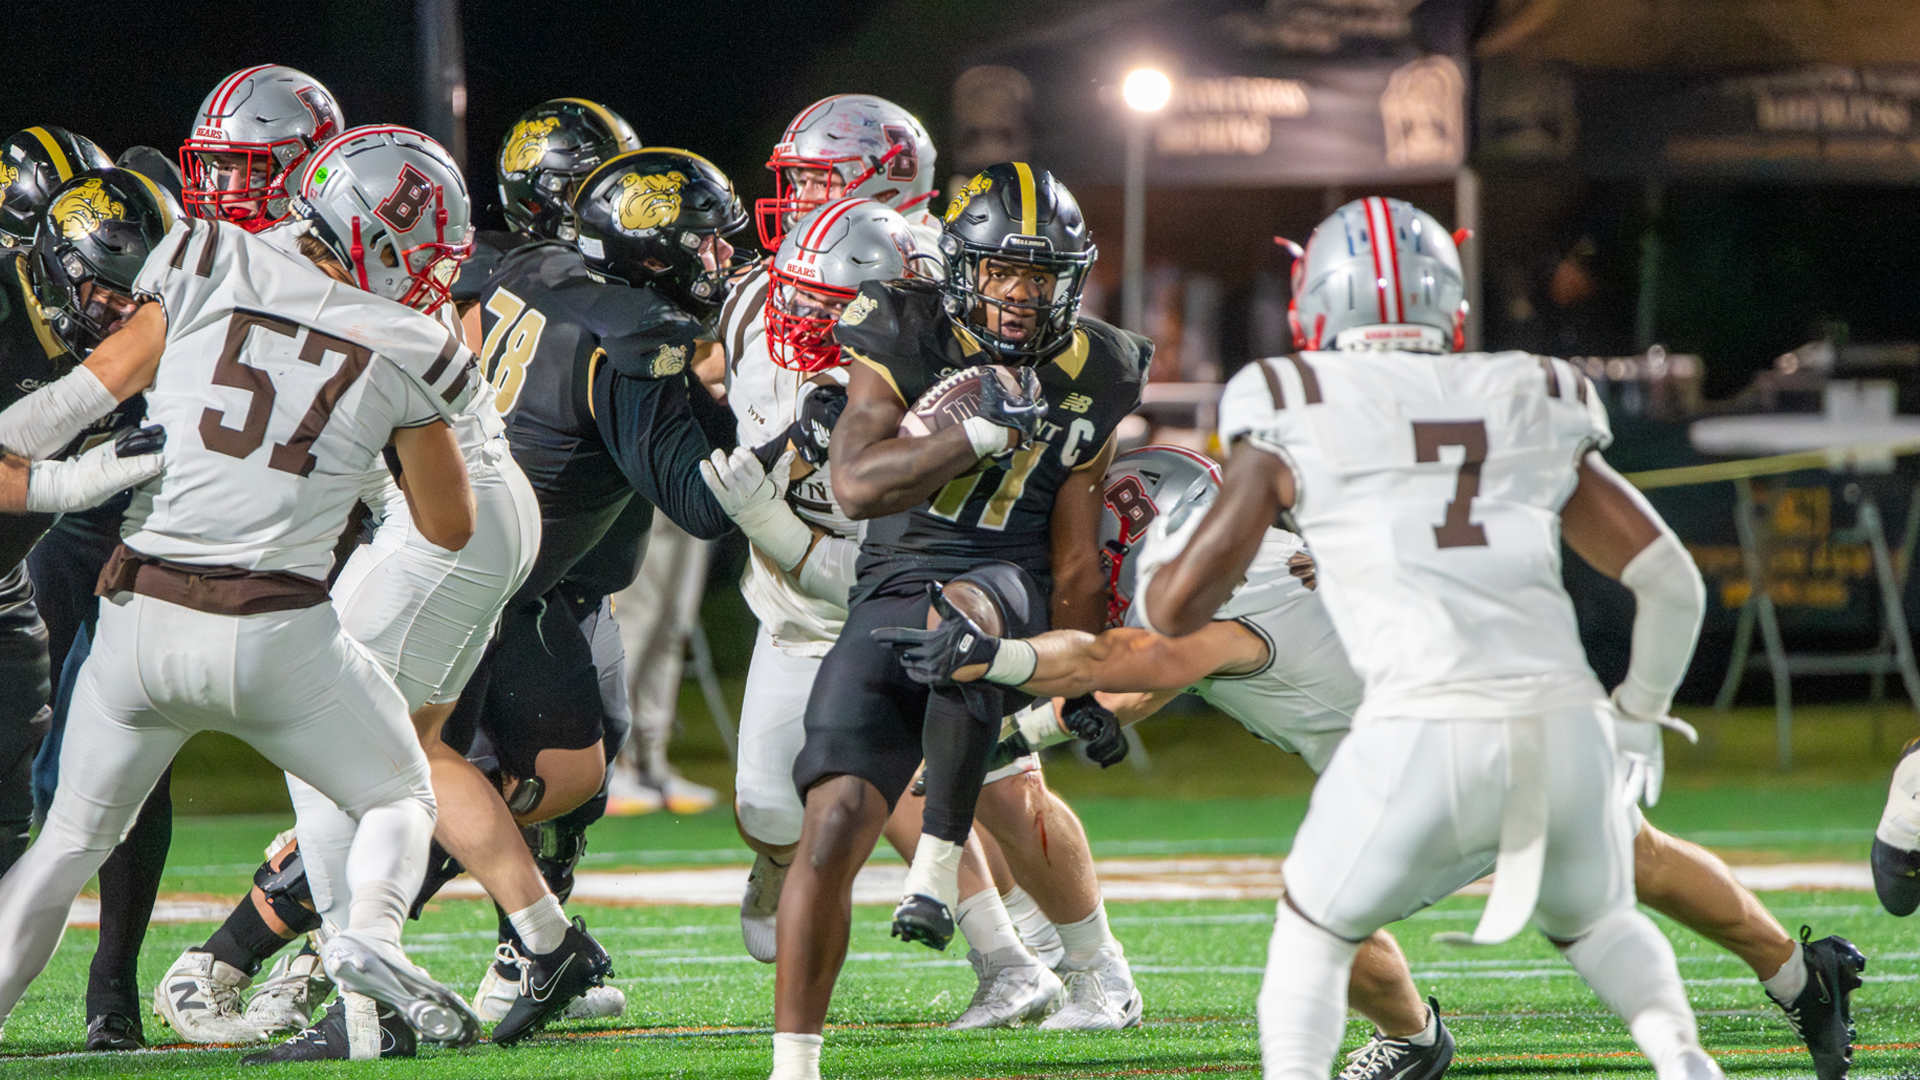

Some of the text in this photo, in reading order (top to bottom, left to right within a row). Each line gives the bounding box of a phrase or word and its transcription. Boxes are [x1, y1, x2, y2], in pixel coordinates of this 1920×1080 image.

[195, 127, 223, 140] BEARS
[373, 162, 435, 234] B
[786, 263, 816, 278] BEARS
[480, 286, 547, 418] 78
[198, 306, 375, 479] 57
[747, 404, 761, 421] Ivy
[1060, 417, 1096, 468] C
[1104, 475, 1160, 545] B
[1412, 420, 1489, 549] 7
